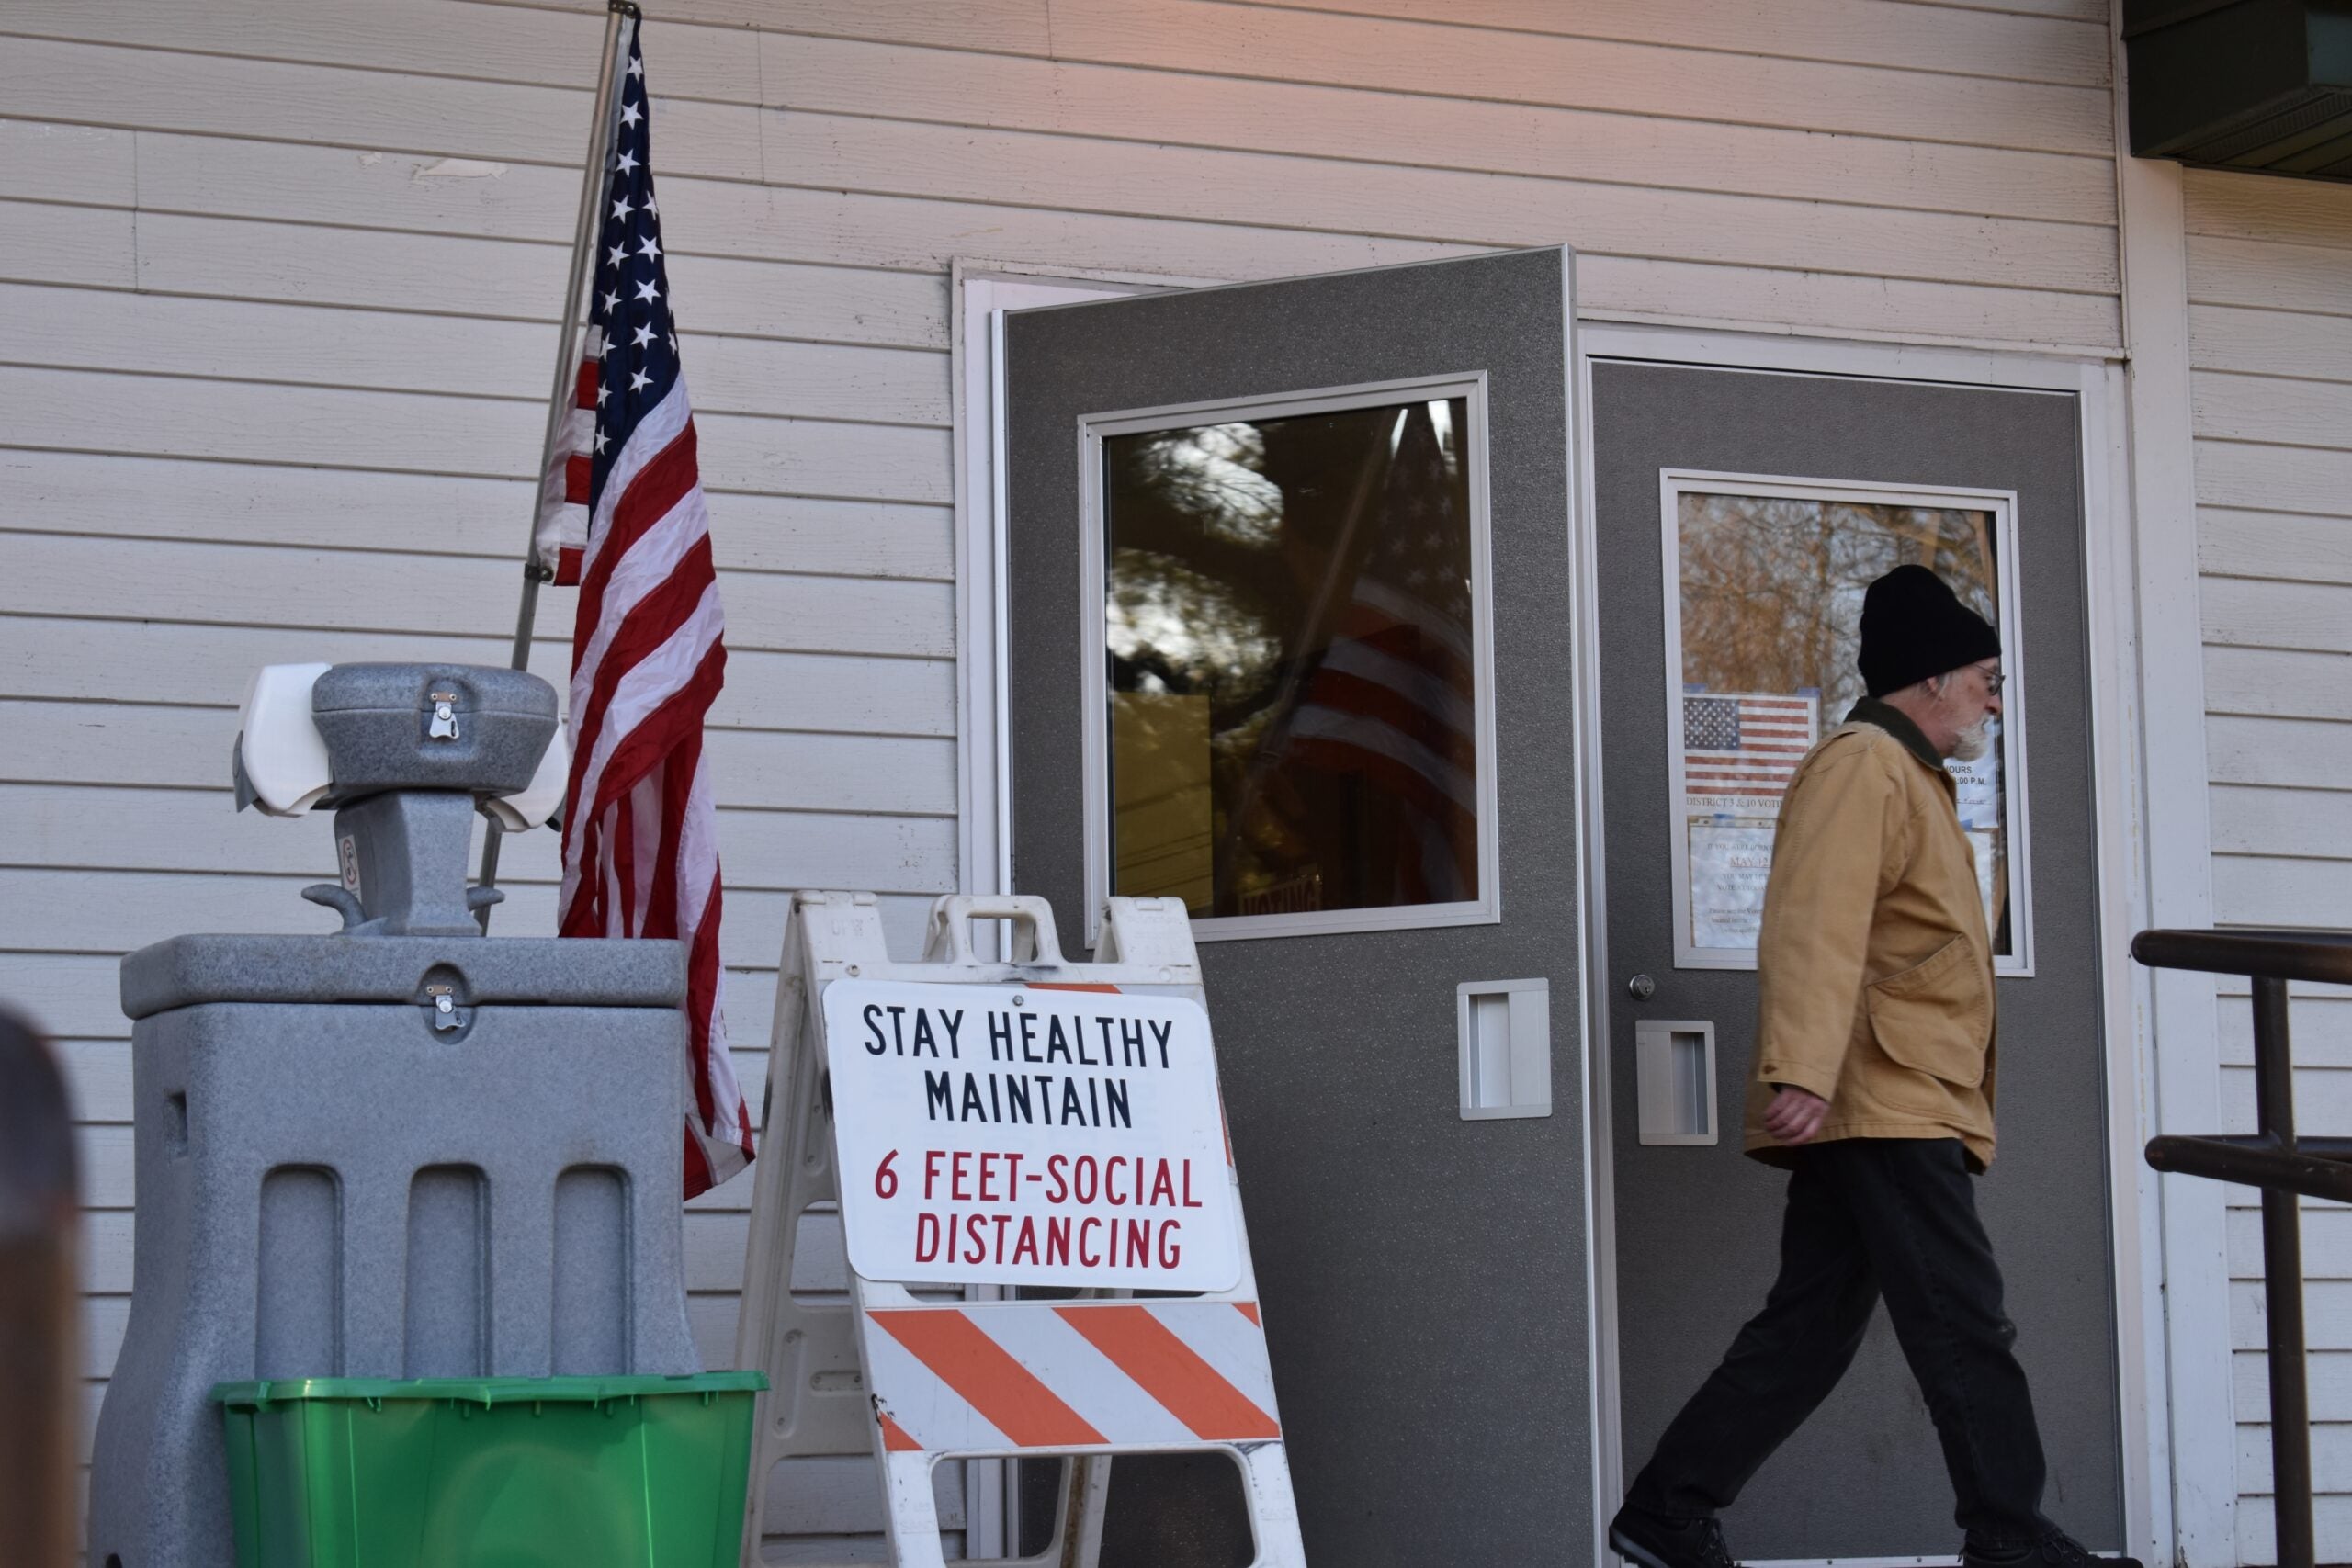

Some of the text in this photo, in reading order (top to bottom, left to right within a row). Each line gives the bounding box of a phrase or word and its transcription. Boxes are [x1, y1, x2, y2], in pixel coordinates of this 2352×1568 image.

[1686, 797, 1727, 808] DISTRICT
[1729, 798, 1735, 807] 3
[1736, 798, 1746, 808] &
[1747, 798, 1757, 807] 10
[1970, 777, 1987, 785] P.M.
[1730, 856, 1754, 868] MAY
[864, 1005, 1171, 1068] STAY HEALTHY
[925, 1070, 1131, 1128] MAINTAIN
[876, 1150, 1202, 1207] 6 FEET-SOCIAL
[916, 1213, 1180, 1269] DISTANCING
